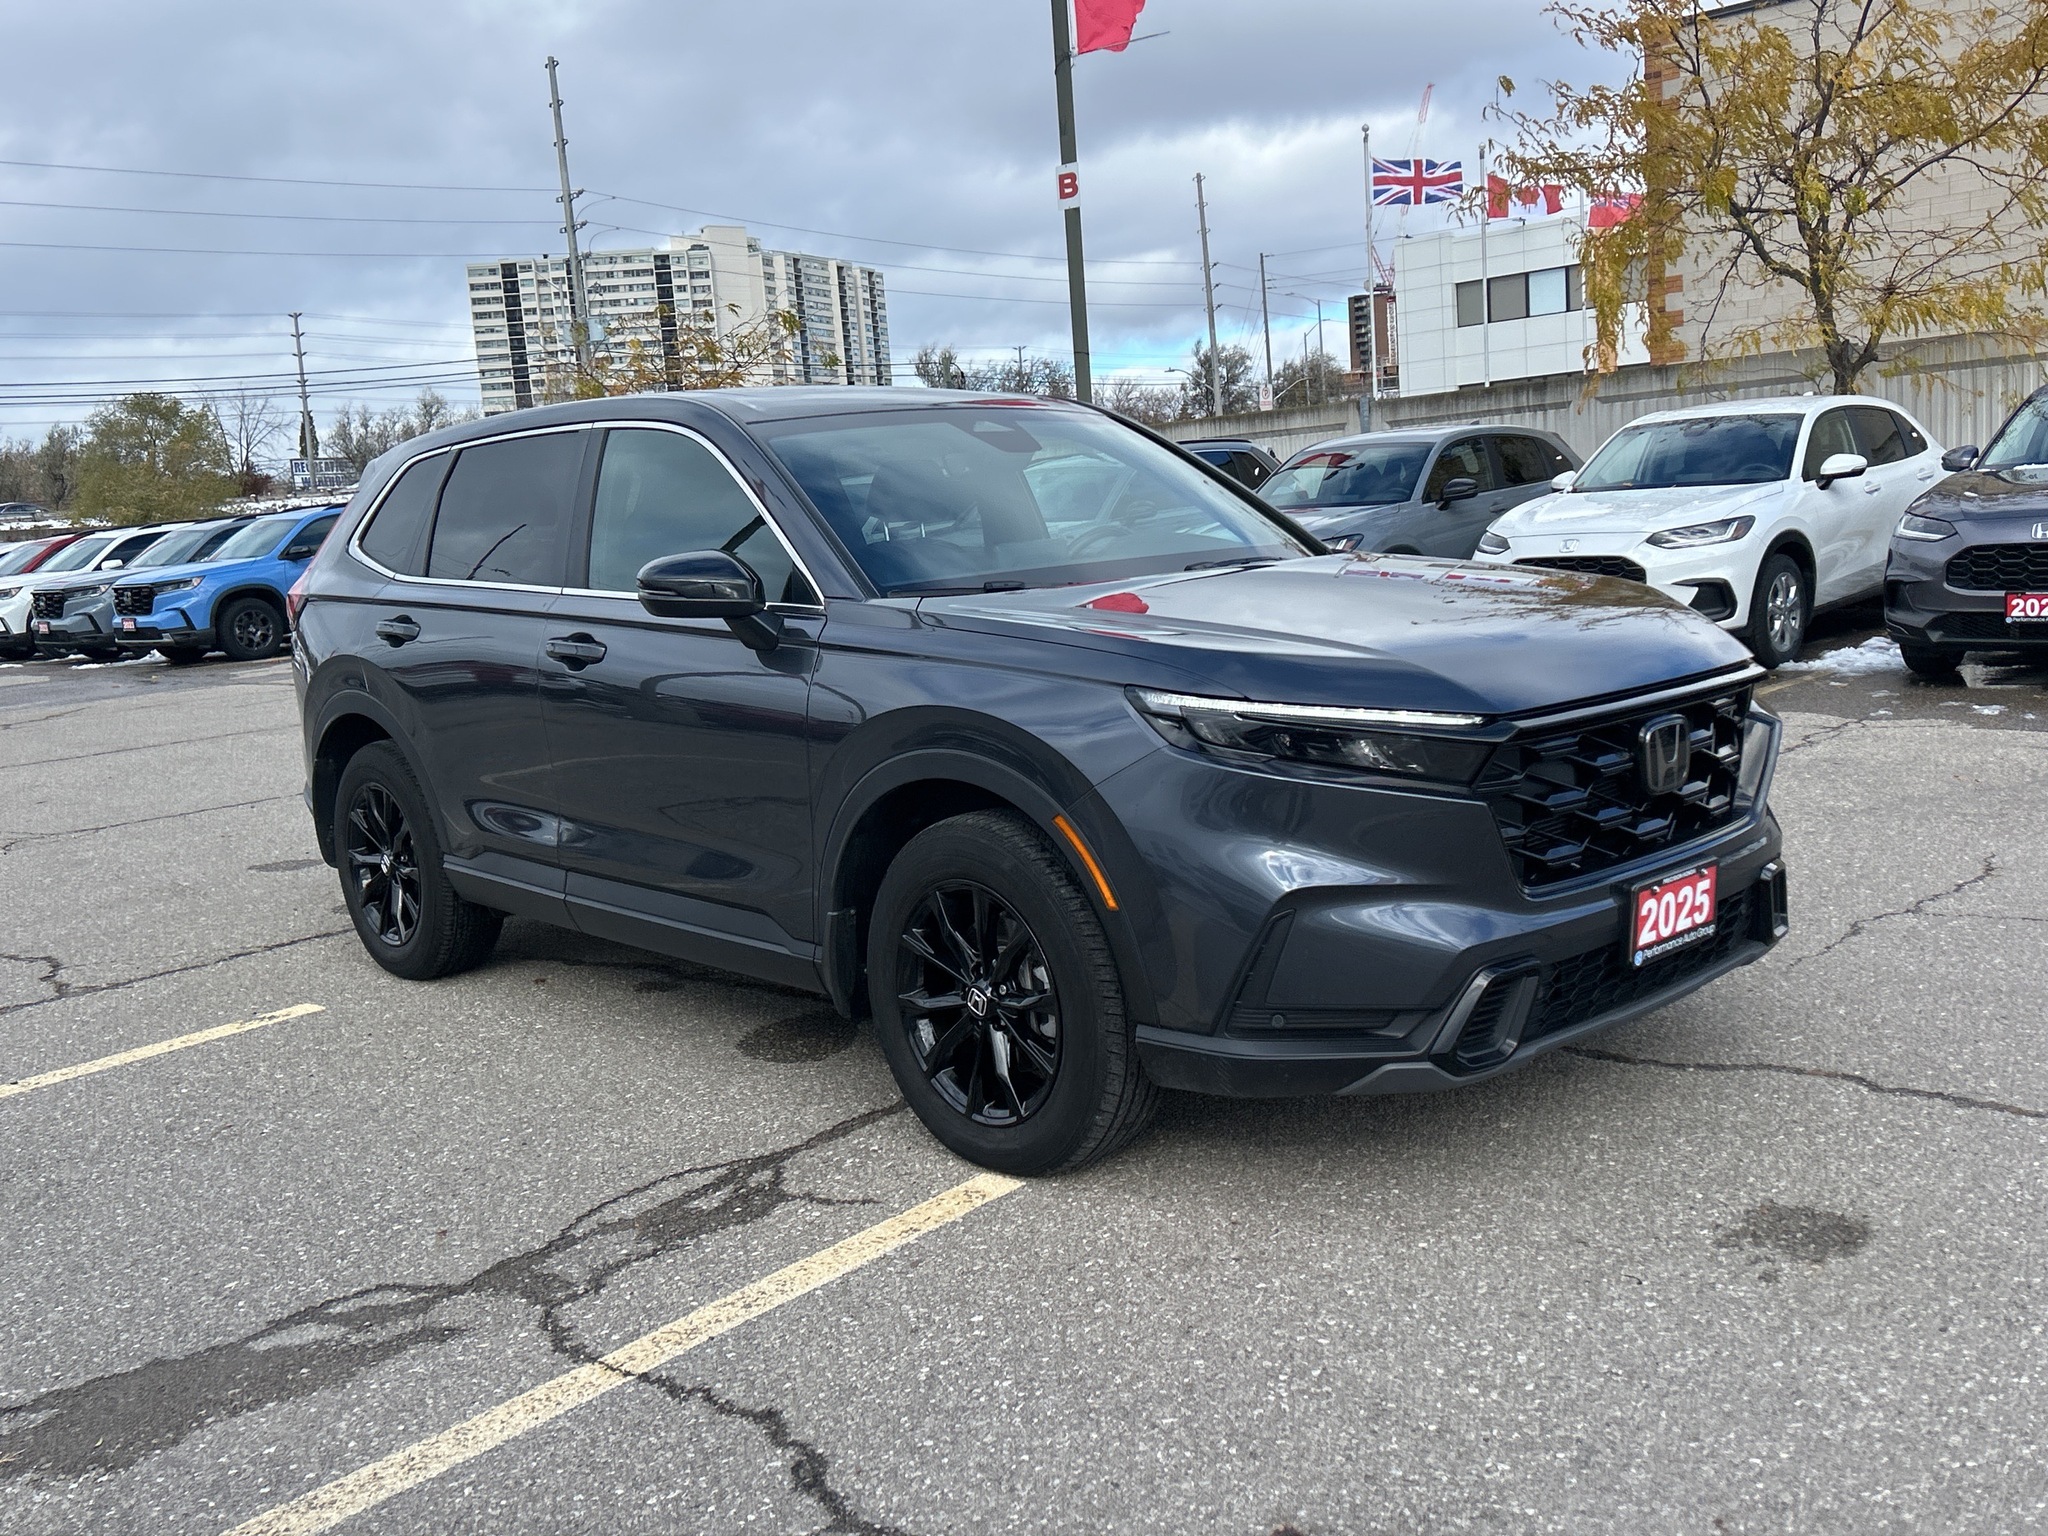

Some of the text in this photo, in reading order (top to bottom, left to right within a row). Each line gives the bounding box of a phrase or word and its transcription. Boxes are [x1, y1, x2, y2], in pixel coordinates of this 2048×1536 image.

[1059, 172, 1078, 199] B
[1639, 879, 1710, 946] 2025
[1643, 924, 1716, 959] Performance Auto Group
